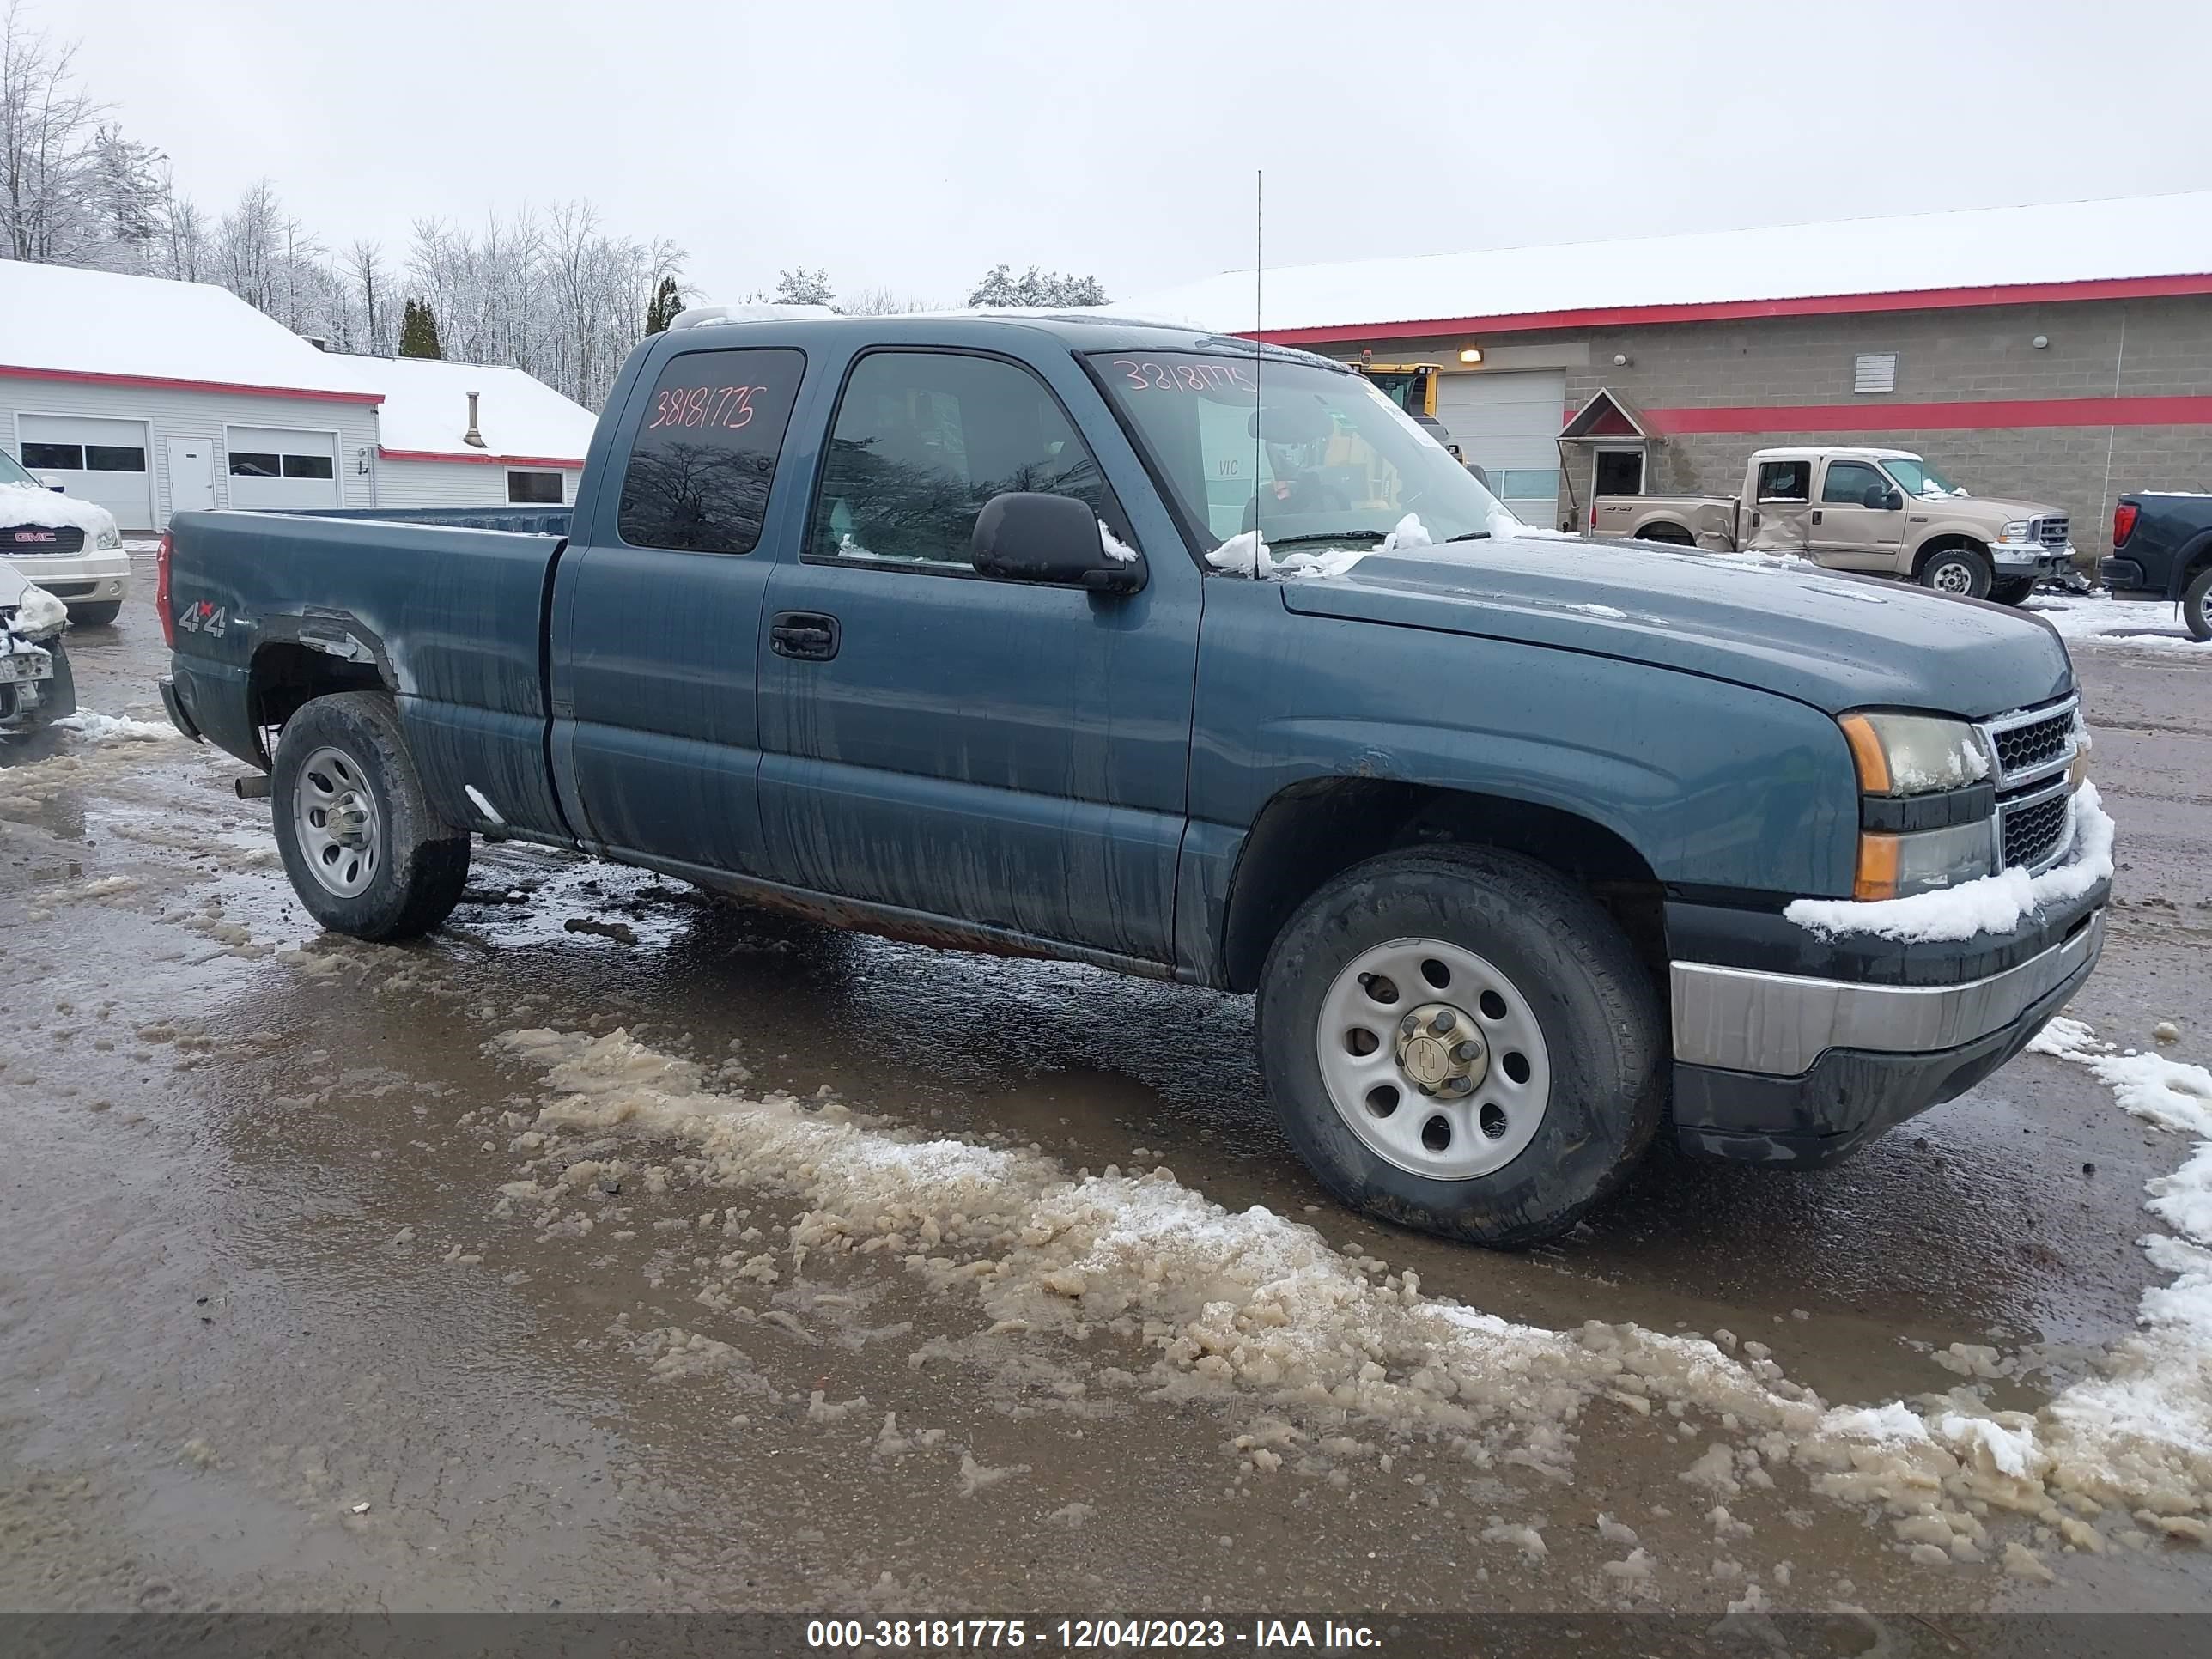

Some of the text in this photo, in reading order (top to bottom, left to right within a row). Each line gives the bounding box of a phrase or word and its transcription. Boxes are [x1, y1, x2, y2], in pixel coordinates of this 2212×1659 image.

[649, 386, 767, 429] 38181775
[1219, 459, 1238, 475] VIC
[14, 532, 57, 542] GMC
